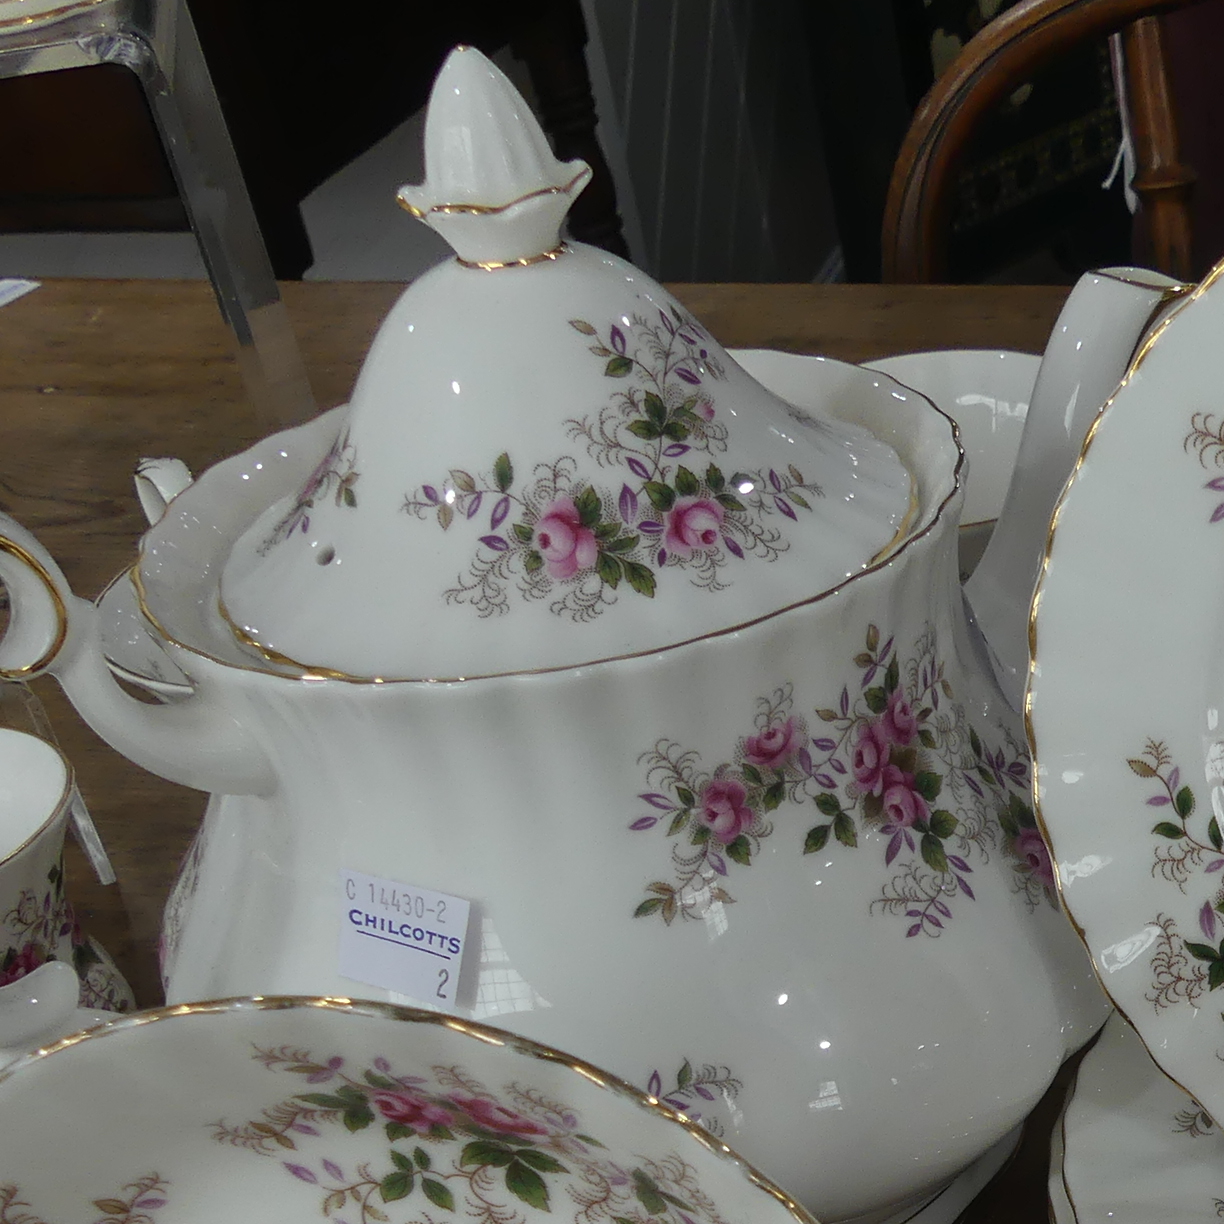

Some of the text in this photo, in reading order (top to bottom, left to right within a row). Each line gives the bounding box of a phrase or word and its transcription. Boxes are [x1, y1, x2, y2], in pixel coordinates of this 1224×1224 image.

[345, 878, 447, 923] C 14430-2
[348, 909, 461, 954] CHILCOTTS
[436, 968, 449, 999] 2
